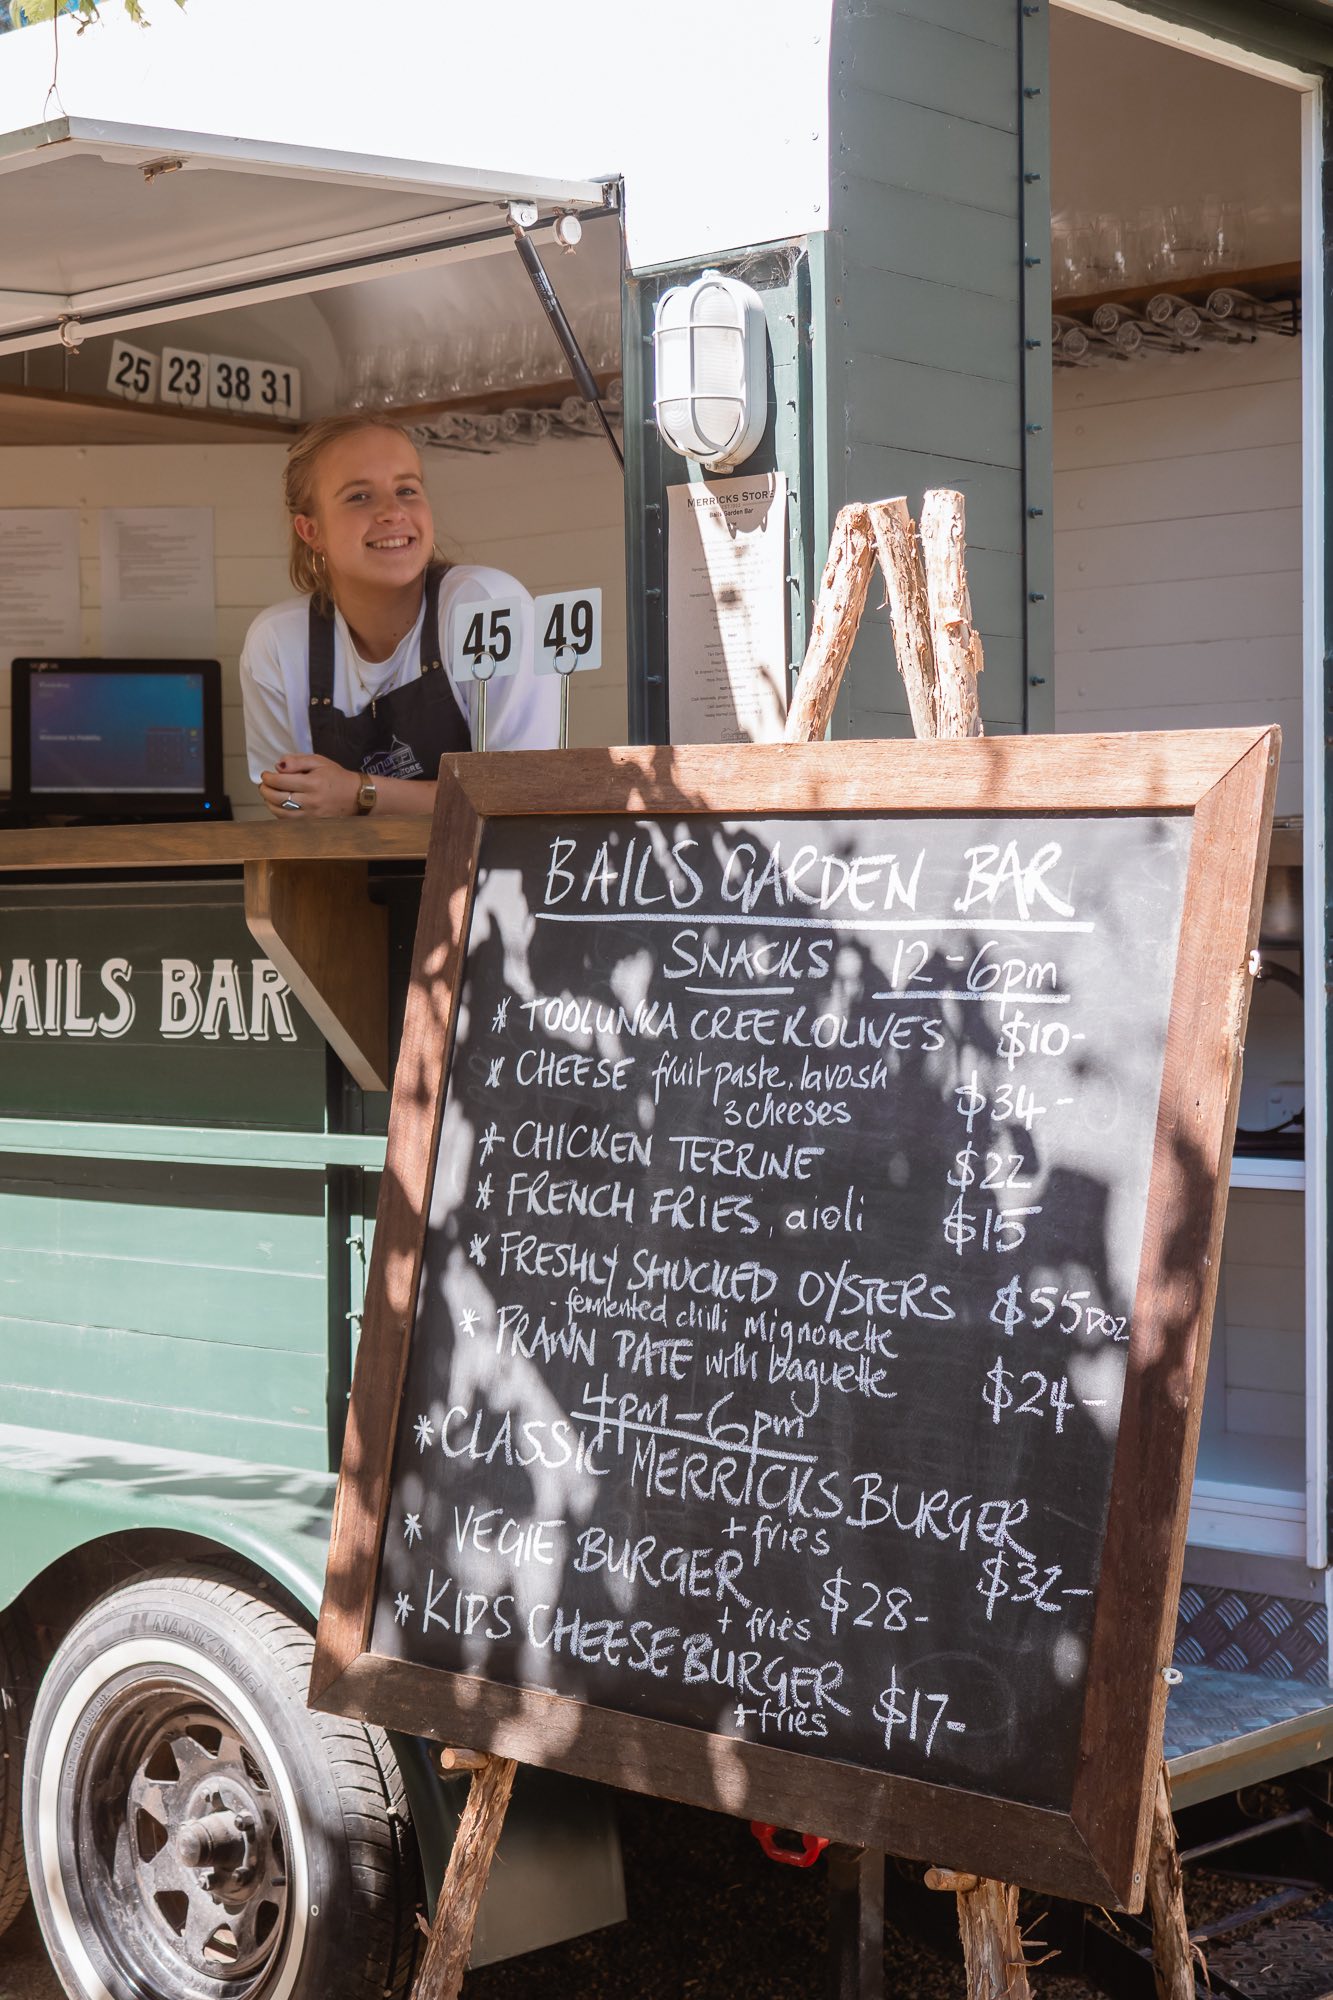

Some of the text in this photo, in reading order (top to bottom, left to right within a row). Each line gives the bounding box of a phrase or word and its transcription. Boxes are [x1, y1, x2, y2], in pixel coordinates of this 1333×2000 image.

[115, 351, 152, 395] 25
[168, 356, 201, 396] 23
[216, 362, 251, 402] 38
[260, 369, 292, 408] 31
[687, 493, 739, 508] MERRICKS
[744, 507, 754, 515] Bar
[462, 608, 512, 664] 45
[543, 599, 594, 657] 49
[543, 835, 1076, 920] BAILS GARDEN BAR
[663, 929, 834, 980] SNACKS
[0, 957, 298, 1042] AILS BAR
[519, 997, 679, 1040] TOOLUNKA
[690, 1005, 812, 1047] CREEK
[810, 1012, 946, 1051] OLIVES
[515, 1049, 636, 1091] CHEESE
[801, 1055, 888, 1093] lavosh
[512, 1120, 1033, 1193] CHICKEN TERRINE $22
[507, 1170, 634, 1224] FRENCH
[784, 1185, 865, 1232] aioli
[942, 1194, 1044, 1256] $15
[500, 1231, 619, 1301] FRESHLY
[626, 1248, 779, 1304] SHUCKED
[797, 1259, 957, 1325] OYSTERS
[495, 1303, 597, 1367] PRAWN
[612, 1329, 694, 1380] PATE
[705, 1341, 759, 1381] with
[675, 1300, 729, 1333] chilli
[441, 1405, 1037, 1562] CLASSIC MERRICKS BURGER
[454, 1505, 752, 1608] VEGIE BURGER
[422, 1568, 515, 1640] KIDS
[151, 1611, 263, 1695] NANKANG
